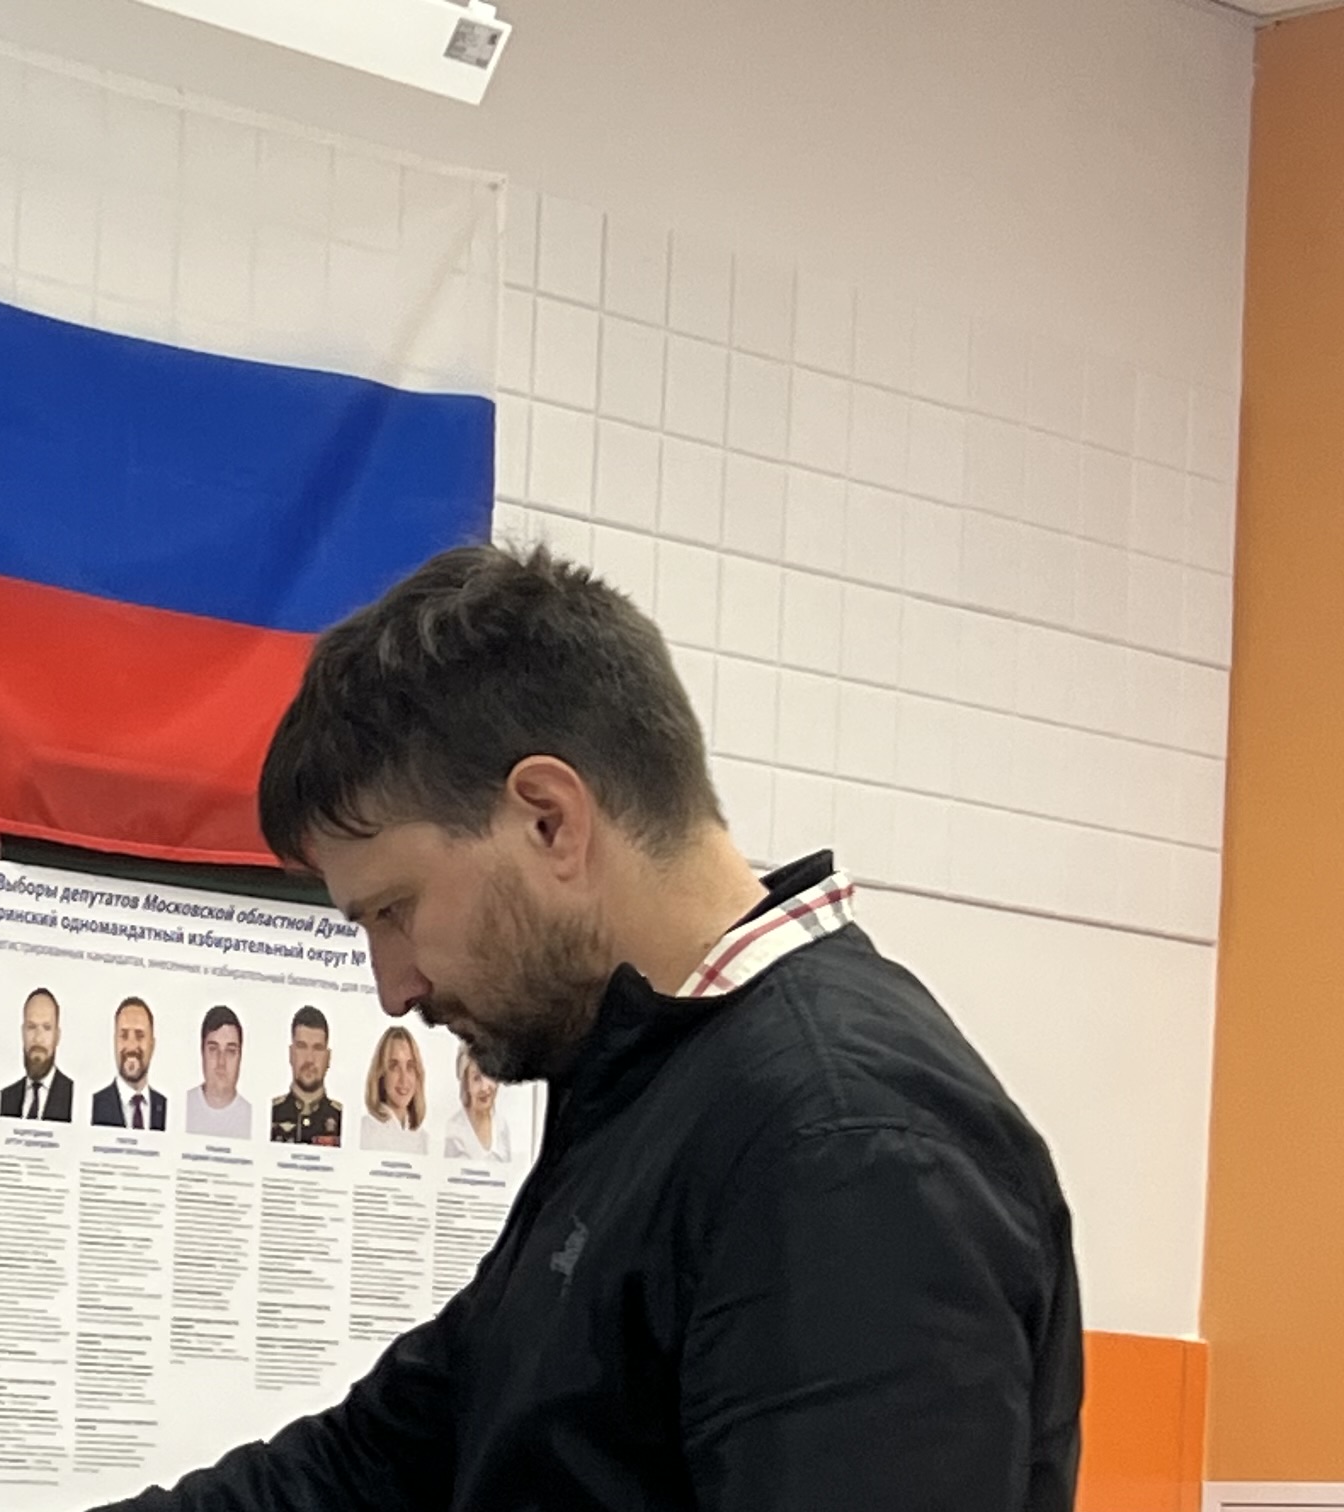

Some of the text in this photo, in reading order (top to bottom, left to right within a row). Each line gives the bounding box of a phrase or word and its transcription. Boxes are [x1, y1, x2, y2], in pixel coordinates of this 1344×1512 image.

[60, 887, 140, 914] депутатов
[142, 894, 235, 922] Московской
[237, 907, 314, 934] областной
[316, 917, 359, 942] Думы
[61, 915, 184, 946] одномандатный
[187, 929, 304, 961] избирательный
[307, 946, 349, 968] округ
[351, 949, 367, 966] №
